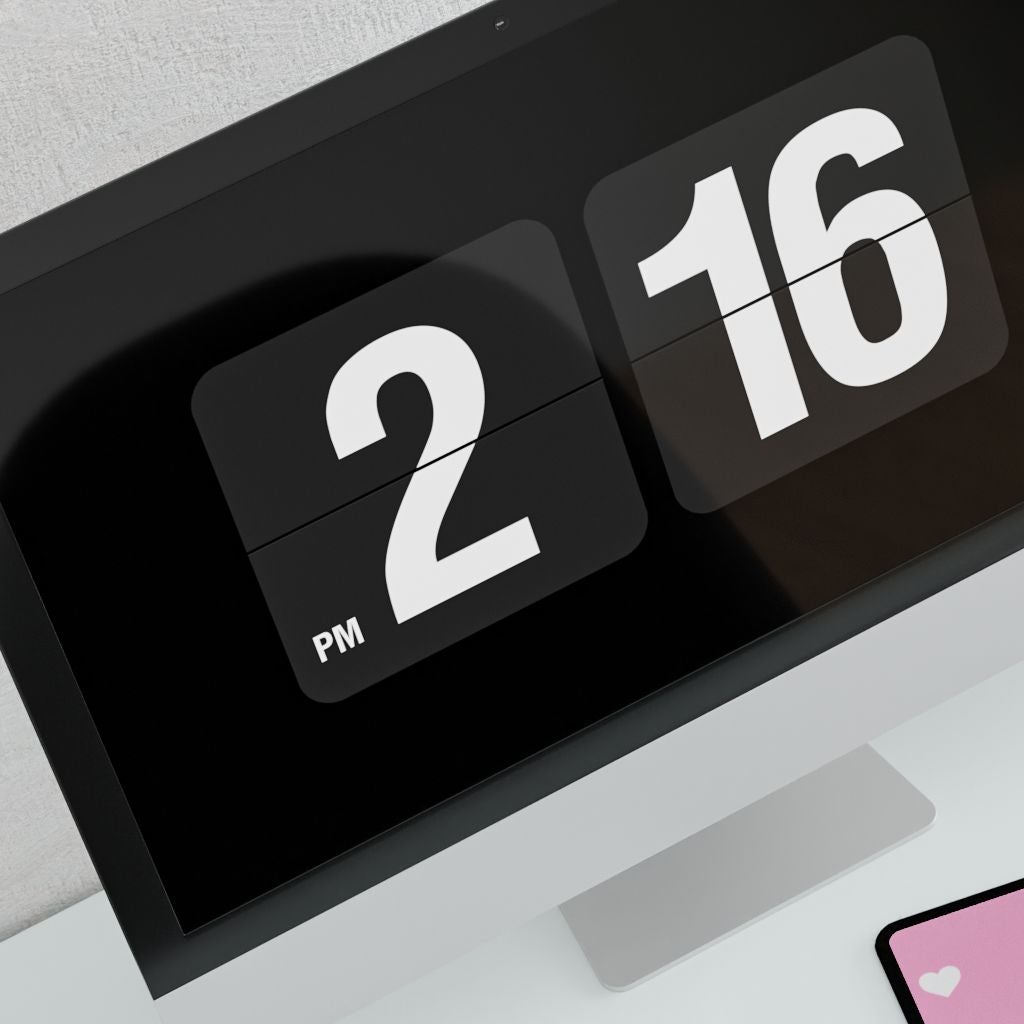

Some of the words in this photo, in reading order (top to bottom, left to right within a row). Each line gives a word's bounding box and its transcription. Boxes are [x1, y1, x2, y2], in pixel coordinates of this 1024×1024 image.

[326, 326, 541, 625] 2
[638, 108, 948, 440] 16
[312, 617, 365, 664] PM
